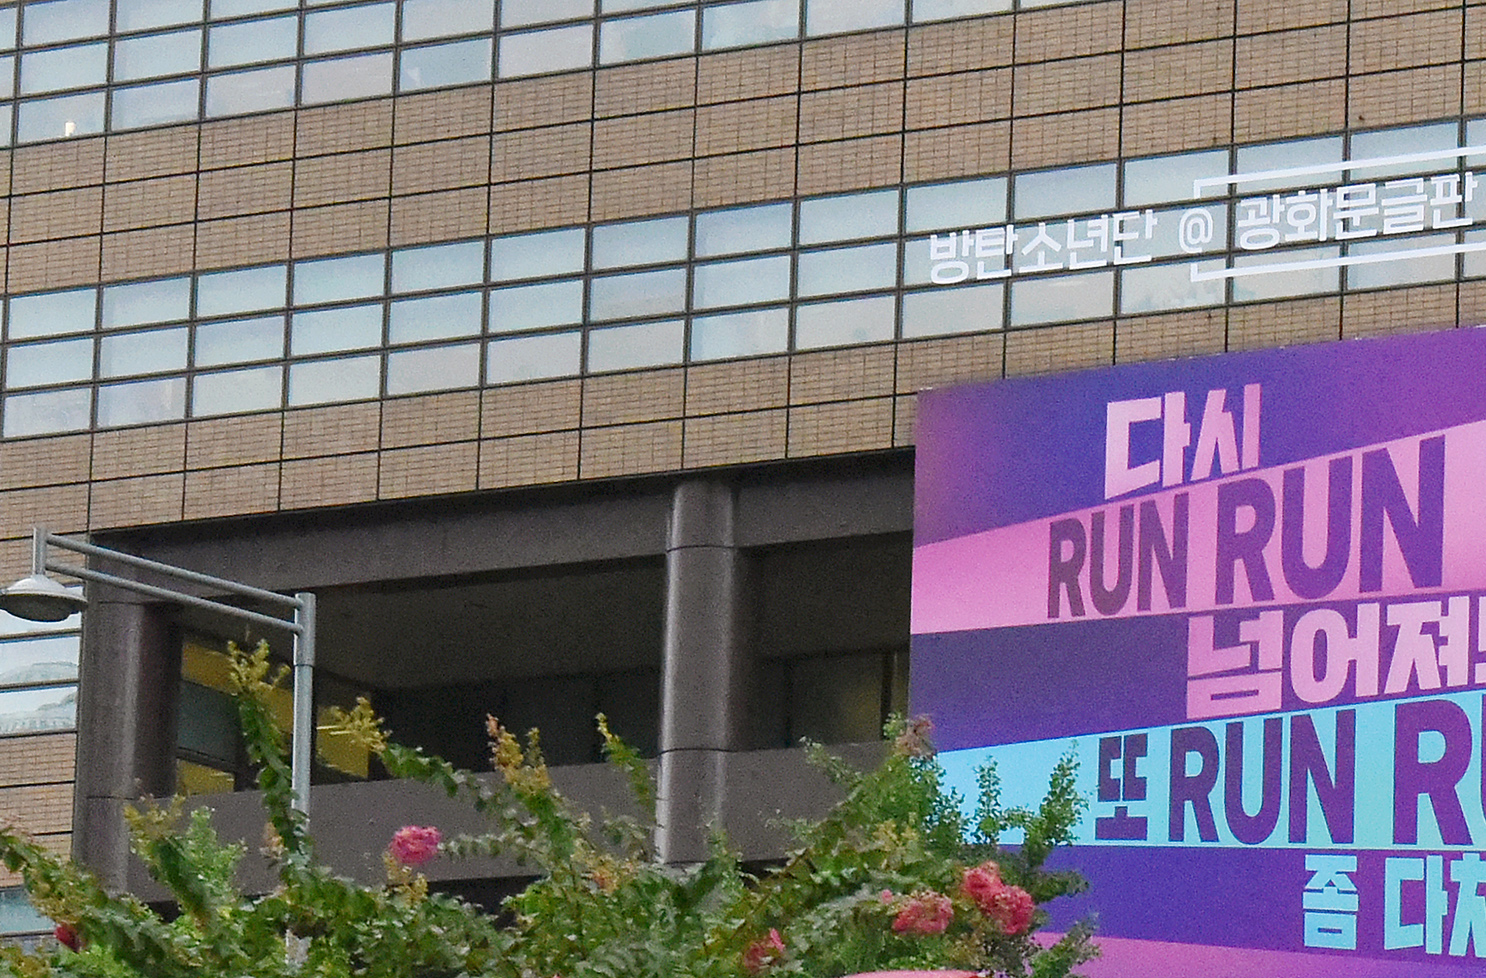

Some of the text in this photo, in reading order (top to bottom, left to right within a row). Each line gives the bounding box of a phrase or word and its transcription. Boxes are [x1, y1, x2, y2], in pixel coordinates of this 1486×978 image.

[929, 171, 1478, 285] 방탄소년단 @ 광화문글판
[1105, 383, 1262, 499] 다시
[1047, 492, 1189, 619] RUN
[1215, 433, 1446, 606] RUN
[1095, 733, 1148, 841] 또
[1169, 710, 1356, 845] RUN
[1303, 855, 1359, 950] 좀
